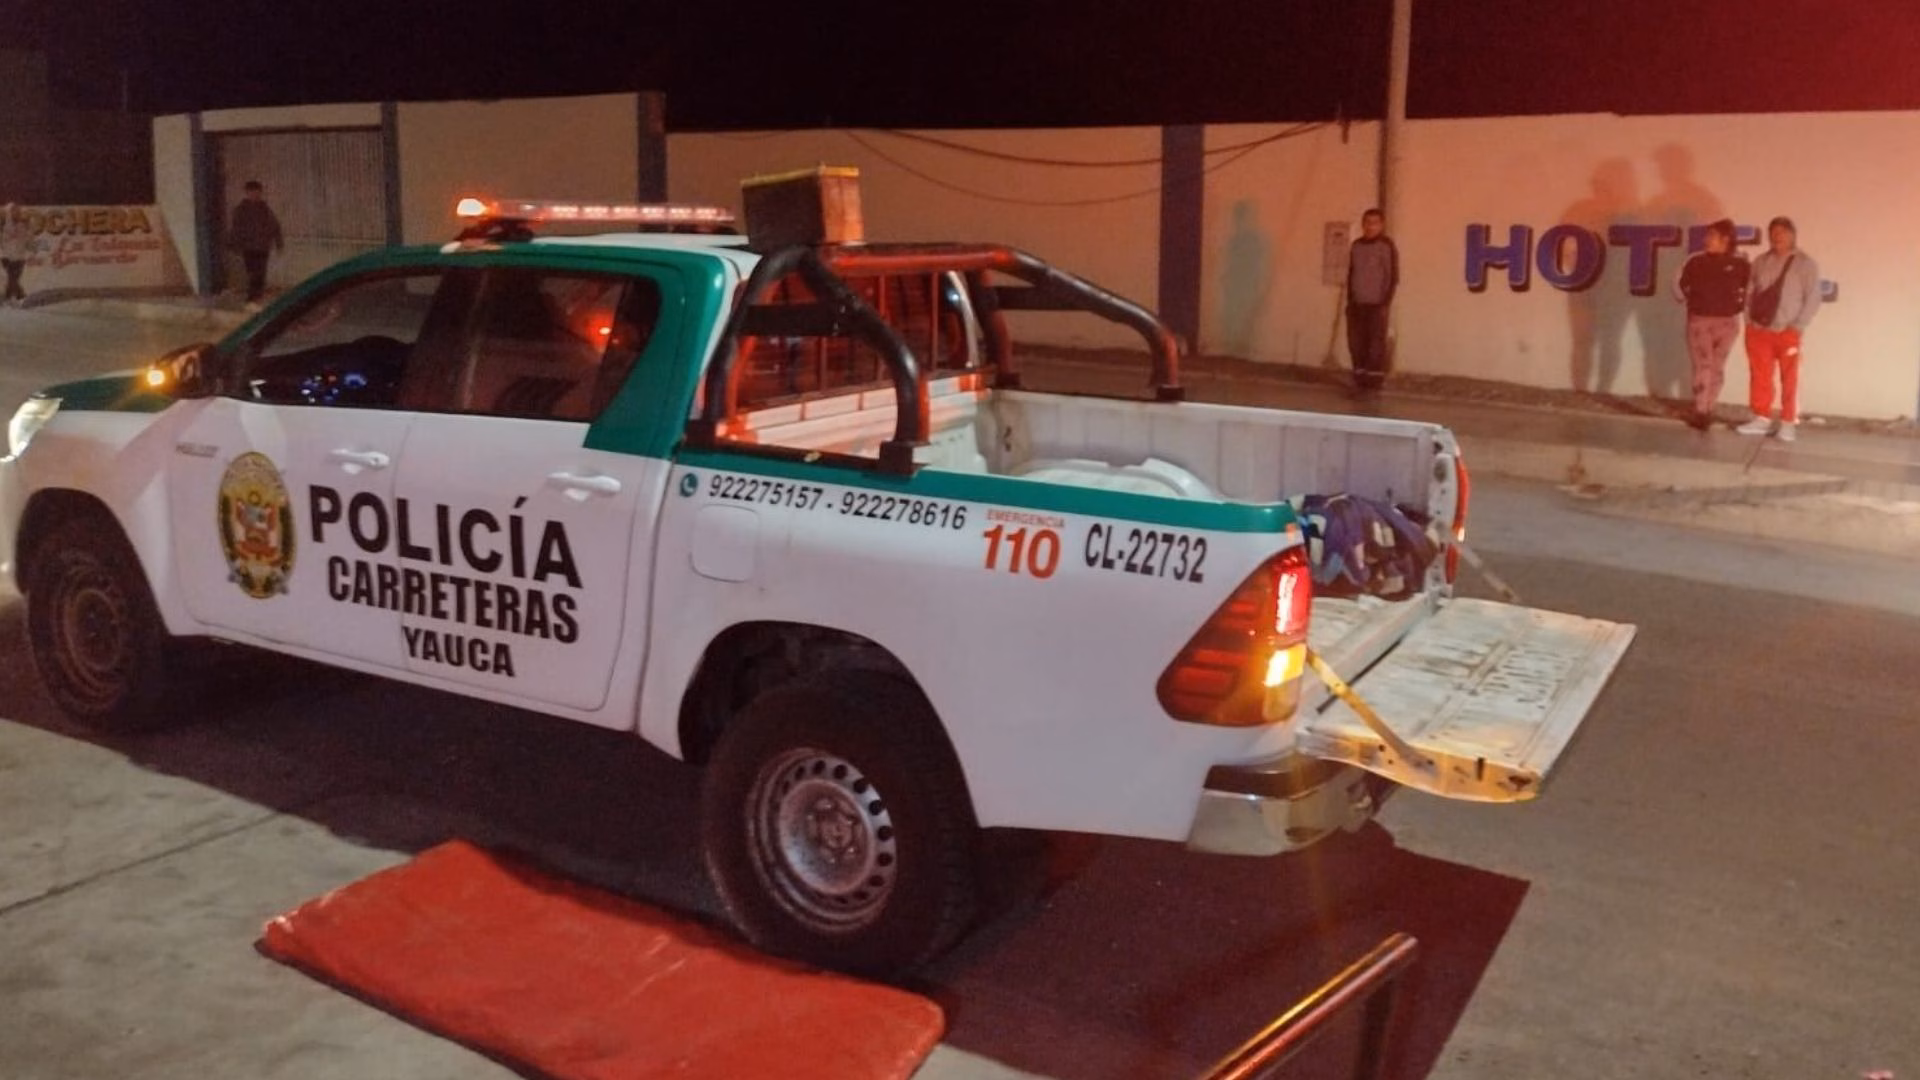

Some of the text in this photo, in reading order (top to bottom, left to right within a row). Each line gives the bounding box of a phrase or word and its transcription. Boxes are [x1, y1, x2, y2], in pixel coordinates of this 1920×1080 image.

[1464, 223, 1839, 302] HOT
[709, 474, 823, 510] 922275157
[840, 491, 967, 530] 922278616
[986, 508, 1066, 529] EMERGENCIA
[309, 484, 582, 588] POLICÍA
[982, 524, 1061, 579] 110
[1085, 523, 1208, 584] CL-22732
[328, 556, 579, 643] CARRETERAS
[403, 626, 516, 677] YAUCA
